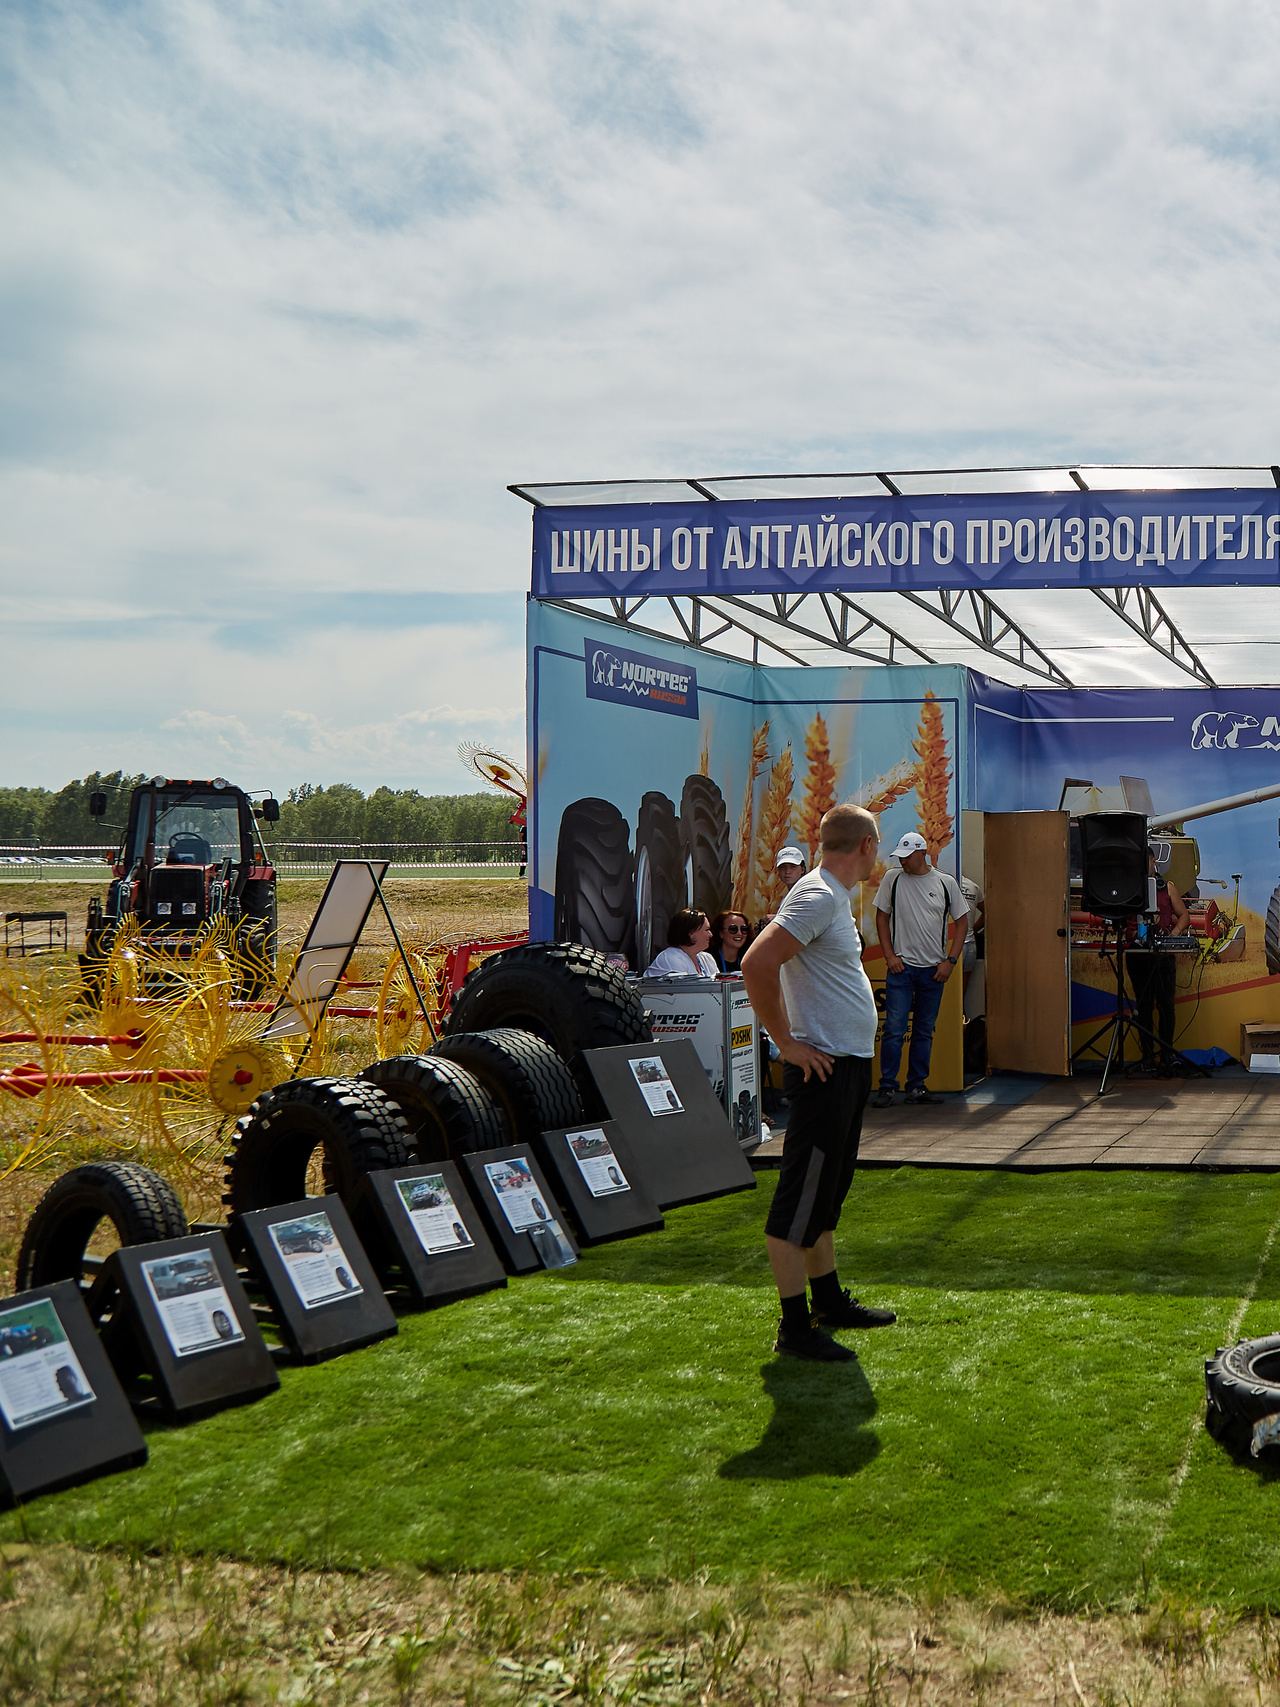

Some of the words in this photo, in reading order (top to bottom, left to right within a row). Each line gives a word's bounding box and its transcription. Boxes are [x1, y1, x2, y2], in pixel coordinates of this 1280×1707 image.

[550, 527, 661, 574] ШИНЫ
[672, 526, 713, 571] ОТ
[722, 514, 955, 570] АЛТАЙСКОГО
[622, 661, 689, 693] NORTEC
[649, 689, 687, 706] RUSSIA
